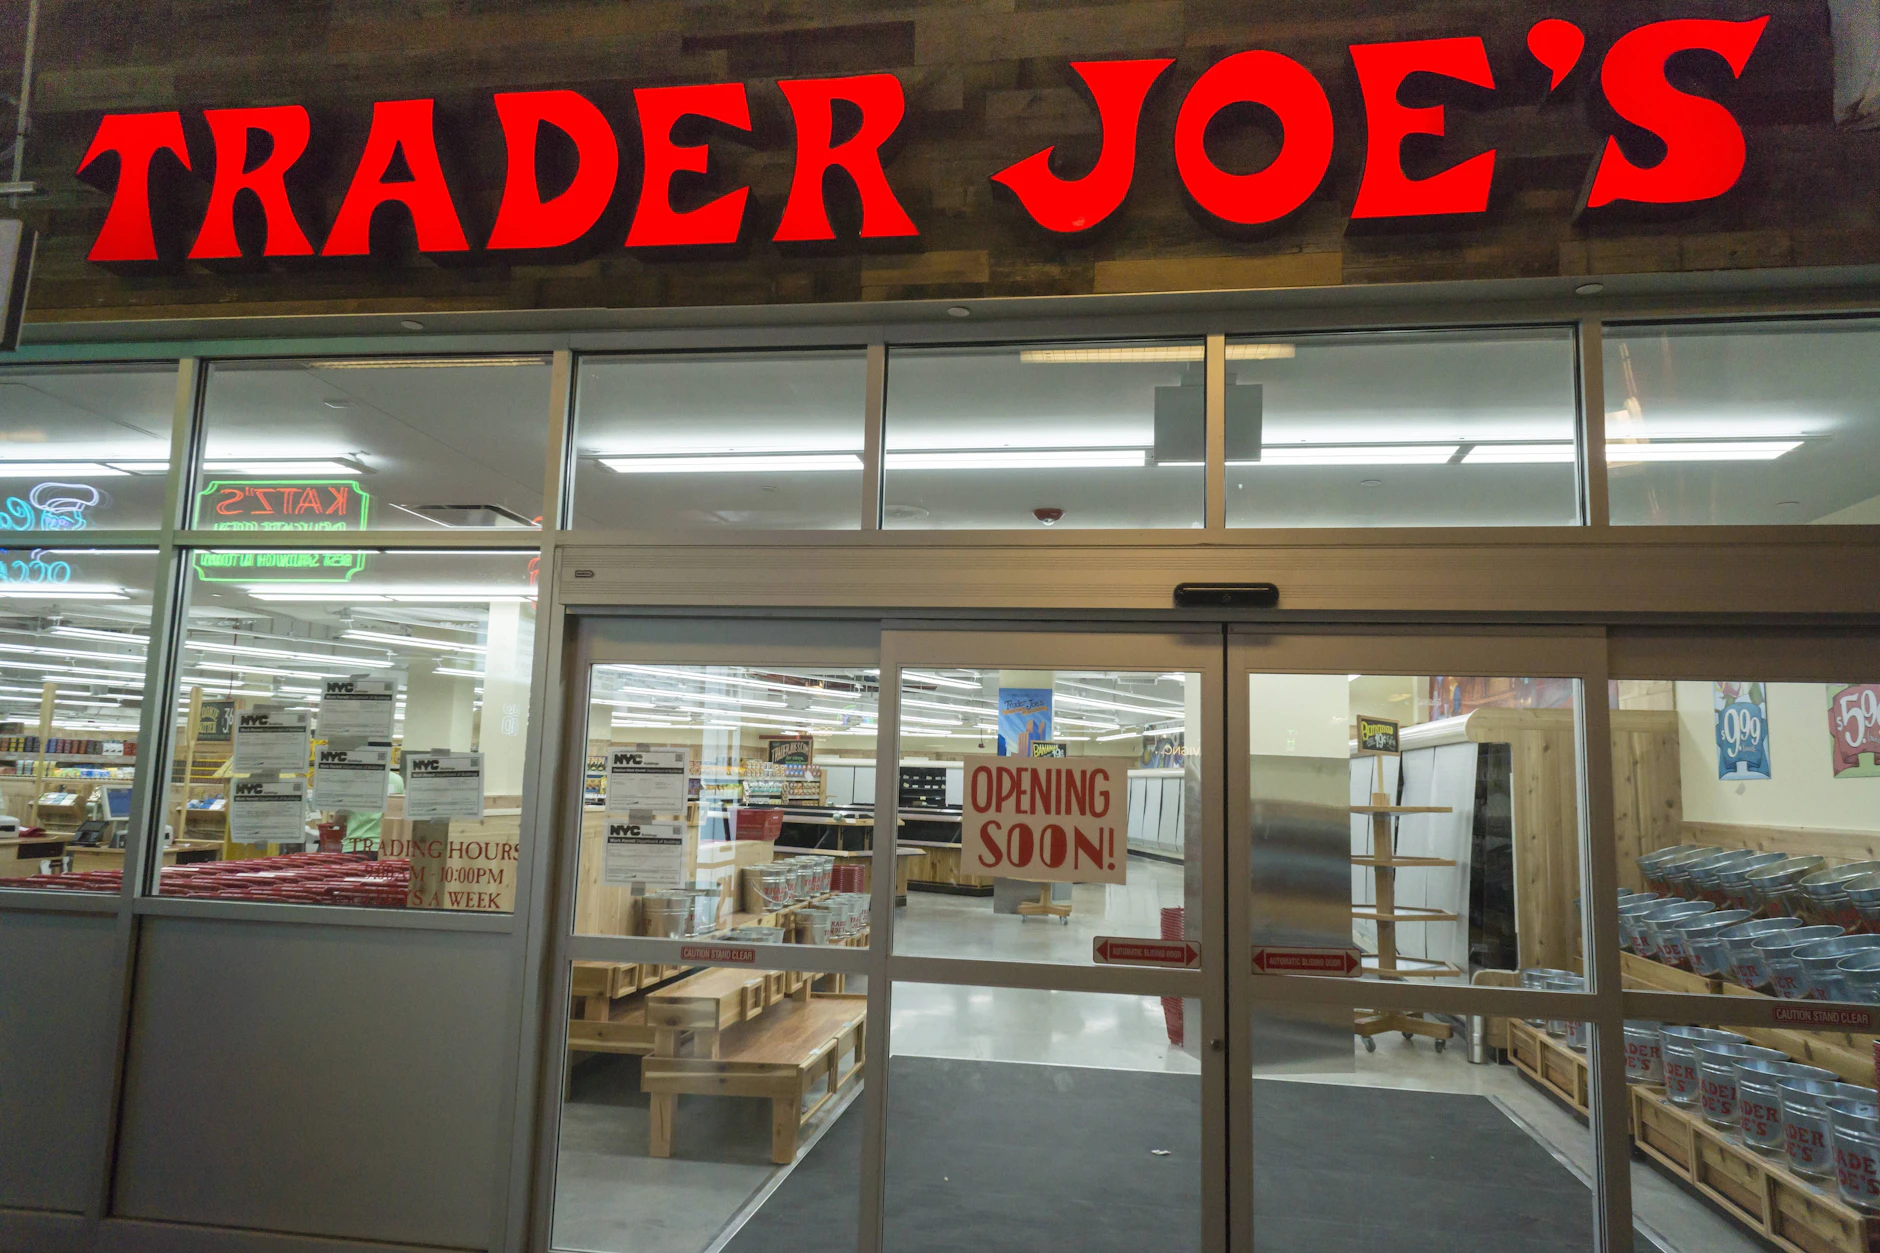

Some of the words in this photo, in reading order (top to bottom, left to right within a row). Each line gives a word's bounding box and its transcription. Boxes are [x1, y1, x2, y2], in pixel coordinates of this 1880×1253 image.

[76, 74, 919, 261] TRADER
[990, 15, 1770, 233] JOE'S
[326, 682, 353, 692] NYC
[241, 715, 269, 725] NYC
[320, 751, 347, 762] NYC
[613, 753, 643, 765] NYC
[412, 759, 439, 771] NYC
[235, 783, 263, 794] NYC
[971, 765, 1110, 818] OPENING
[610, 825, 641, 836] NYC
[350, 838, 443, 859] TRADING
[978, 820, 1116, 871] SOON!
[440, 866, 504, 884] 10:00PM
[447, 891, 502, 909] WEEK
[683, 948, 710, 958] CAUTION
[711, 949, 730, 959] STAND
[731, 950, 753, 960] CLEAR
[1112, 947, 1143, 957] AUTOMATIC
[1269, 957, 1300, 966] AUTOMATIC
[1776, 1008, 1811, 1021] CAUTION
[1812, 1010, 1840, 1023] STAND
[1840, 1013, 1869, 1025] CLEAR
